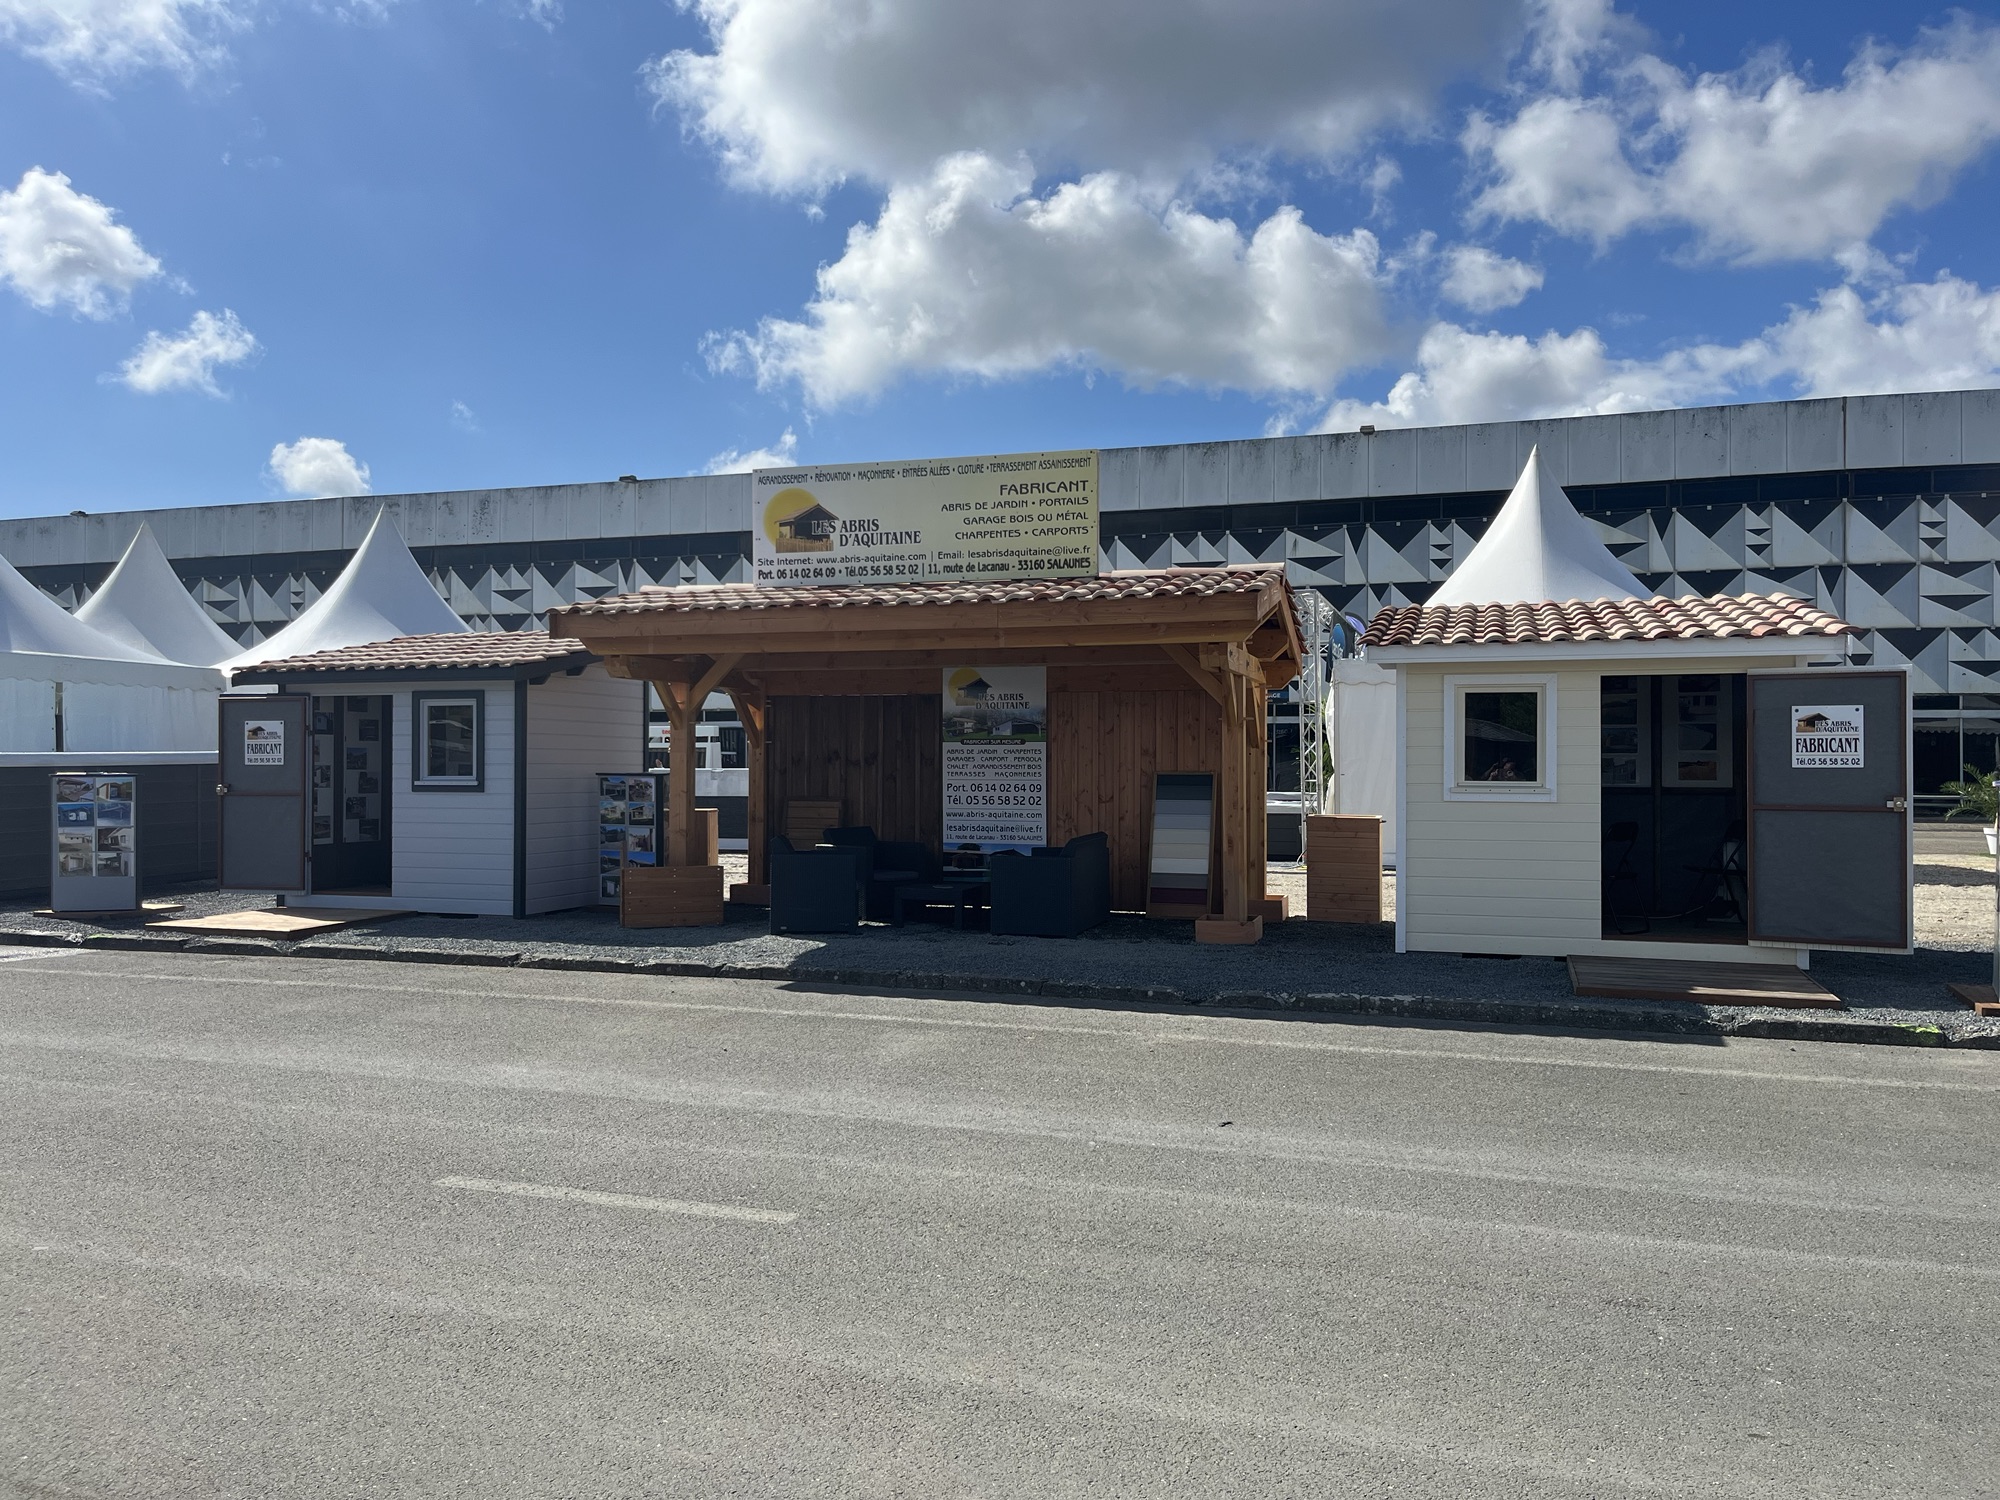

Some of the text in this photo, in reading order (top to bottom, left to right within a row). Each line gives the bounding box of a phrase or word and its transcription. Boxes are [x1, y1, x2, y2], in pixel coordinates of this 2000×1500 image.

[758, 474, 808, 485] AGRANDISSEMENT
[815, 470, 850, 482] RÉNOVATION
[858, 469, 895, 481] MAÇONNERIE
[902, 465, 928, 478] ENTRÉES
[929, 464, 950, 476] ALLÉES
[958, 464, 984, 474] CLOTURE
[1038, 457, 1091, 469] ASSAINISSEMENT
[1000, 480, 1089, 496] FABRICANT
[941, 497, 1089, 512] ABRIS DE JARDIN PORTAILS
[963, 510, 1088, 525] GARAGE BOIS OU MÉTAL
[812, 519, 879, 534] LES ABRIS
[955, 526, 1089, 540] CHARPENTES CARPORTS
[840, 531, 921, 548] D'AQUITAINE
[758, 545, 1090, 566] Site Internet: www.abris-aquitaine.com Email: lesabrisdaquitaine@live.fr
[758, 570, 775, 580] Port.
[777, 569, 787, 579] 06
[789, 569, 799, 578] 14
[801, 568, 811, 578] 02
[813, 568, 824, 578] 64
[825, 567, 836, 577] 09
[870, 566, 881, 576] 56
[883, 565, 893, 576] 58
[895, 565, 906, 575] 52
[908, 564, 919, 574] 02
[928, 564, 940, 575] 11,
[943, 563, 964, 573] route
[966, 562, 976, 573] de
[978, 561, 1009, 572] Lacanau
[1018, 559, 1045, 571] 33160
[1047, 558, 1090, 569] SALAUNES
[979, 693, 995, 701] LES
[247, 744, 281, 754] FABRICANT
[1796, 738, 1859, 752] FABRICANT
[947, 783, 1042, 792] Port. 06 14 02 64 09
[947, 795, 1042, 805] Tél. 05 56 58 52 02
[946, 811, 1042, 819] www.abris-aquitaine.com
[947, 824, 1042, 834] lesabrisdaquitaine@live.fr
